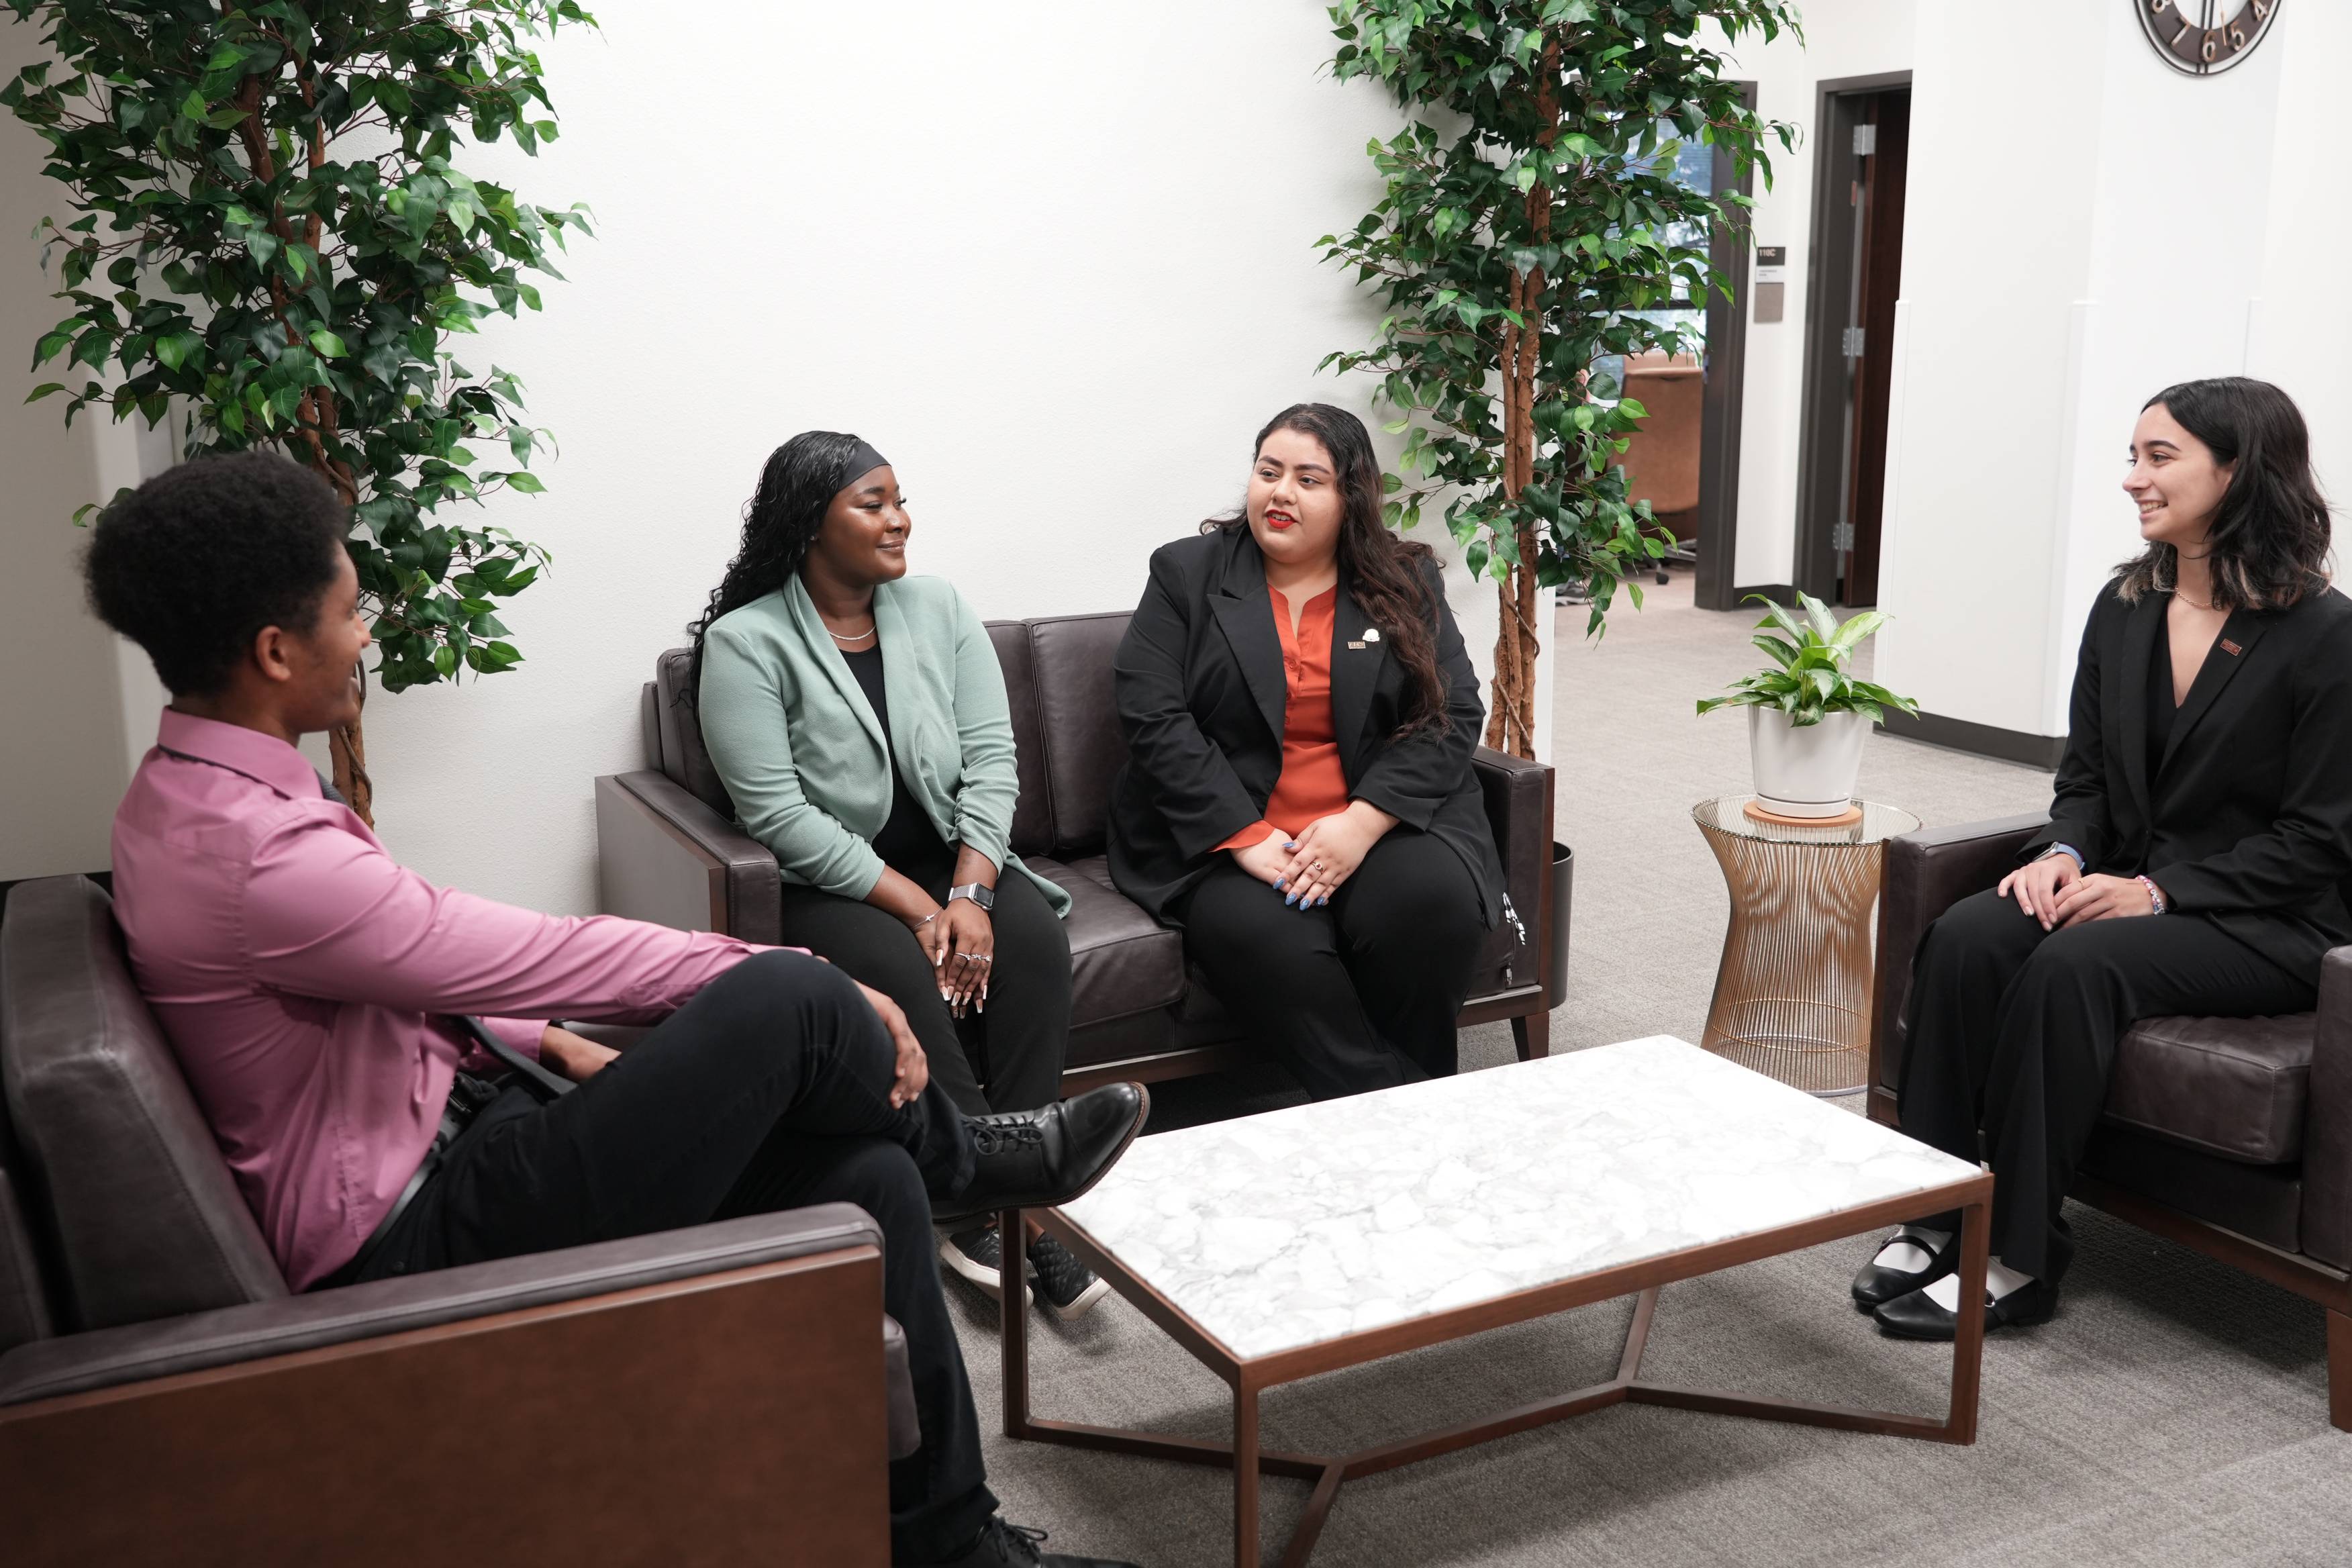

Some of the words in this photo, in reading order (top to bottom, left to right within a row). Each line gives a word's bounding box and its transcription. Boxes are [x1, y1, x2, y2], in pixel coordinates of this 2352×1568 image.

[2251, 0, 2269, 21] 4
[2171, 16, 2191, 46] 7
[2202, 30, 2217, 62] 6
[2230, 19, 2245, 51] 5
